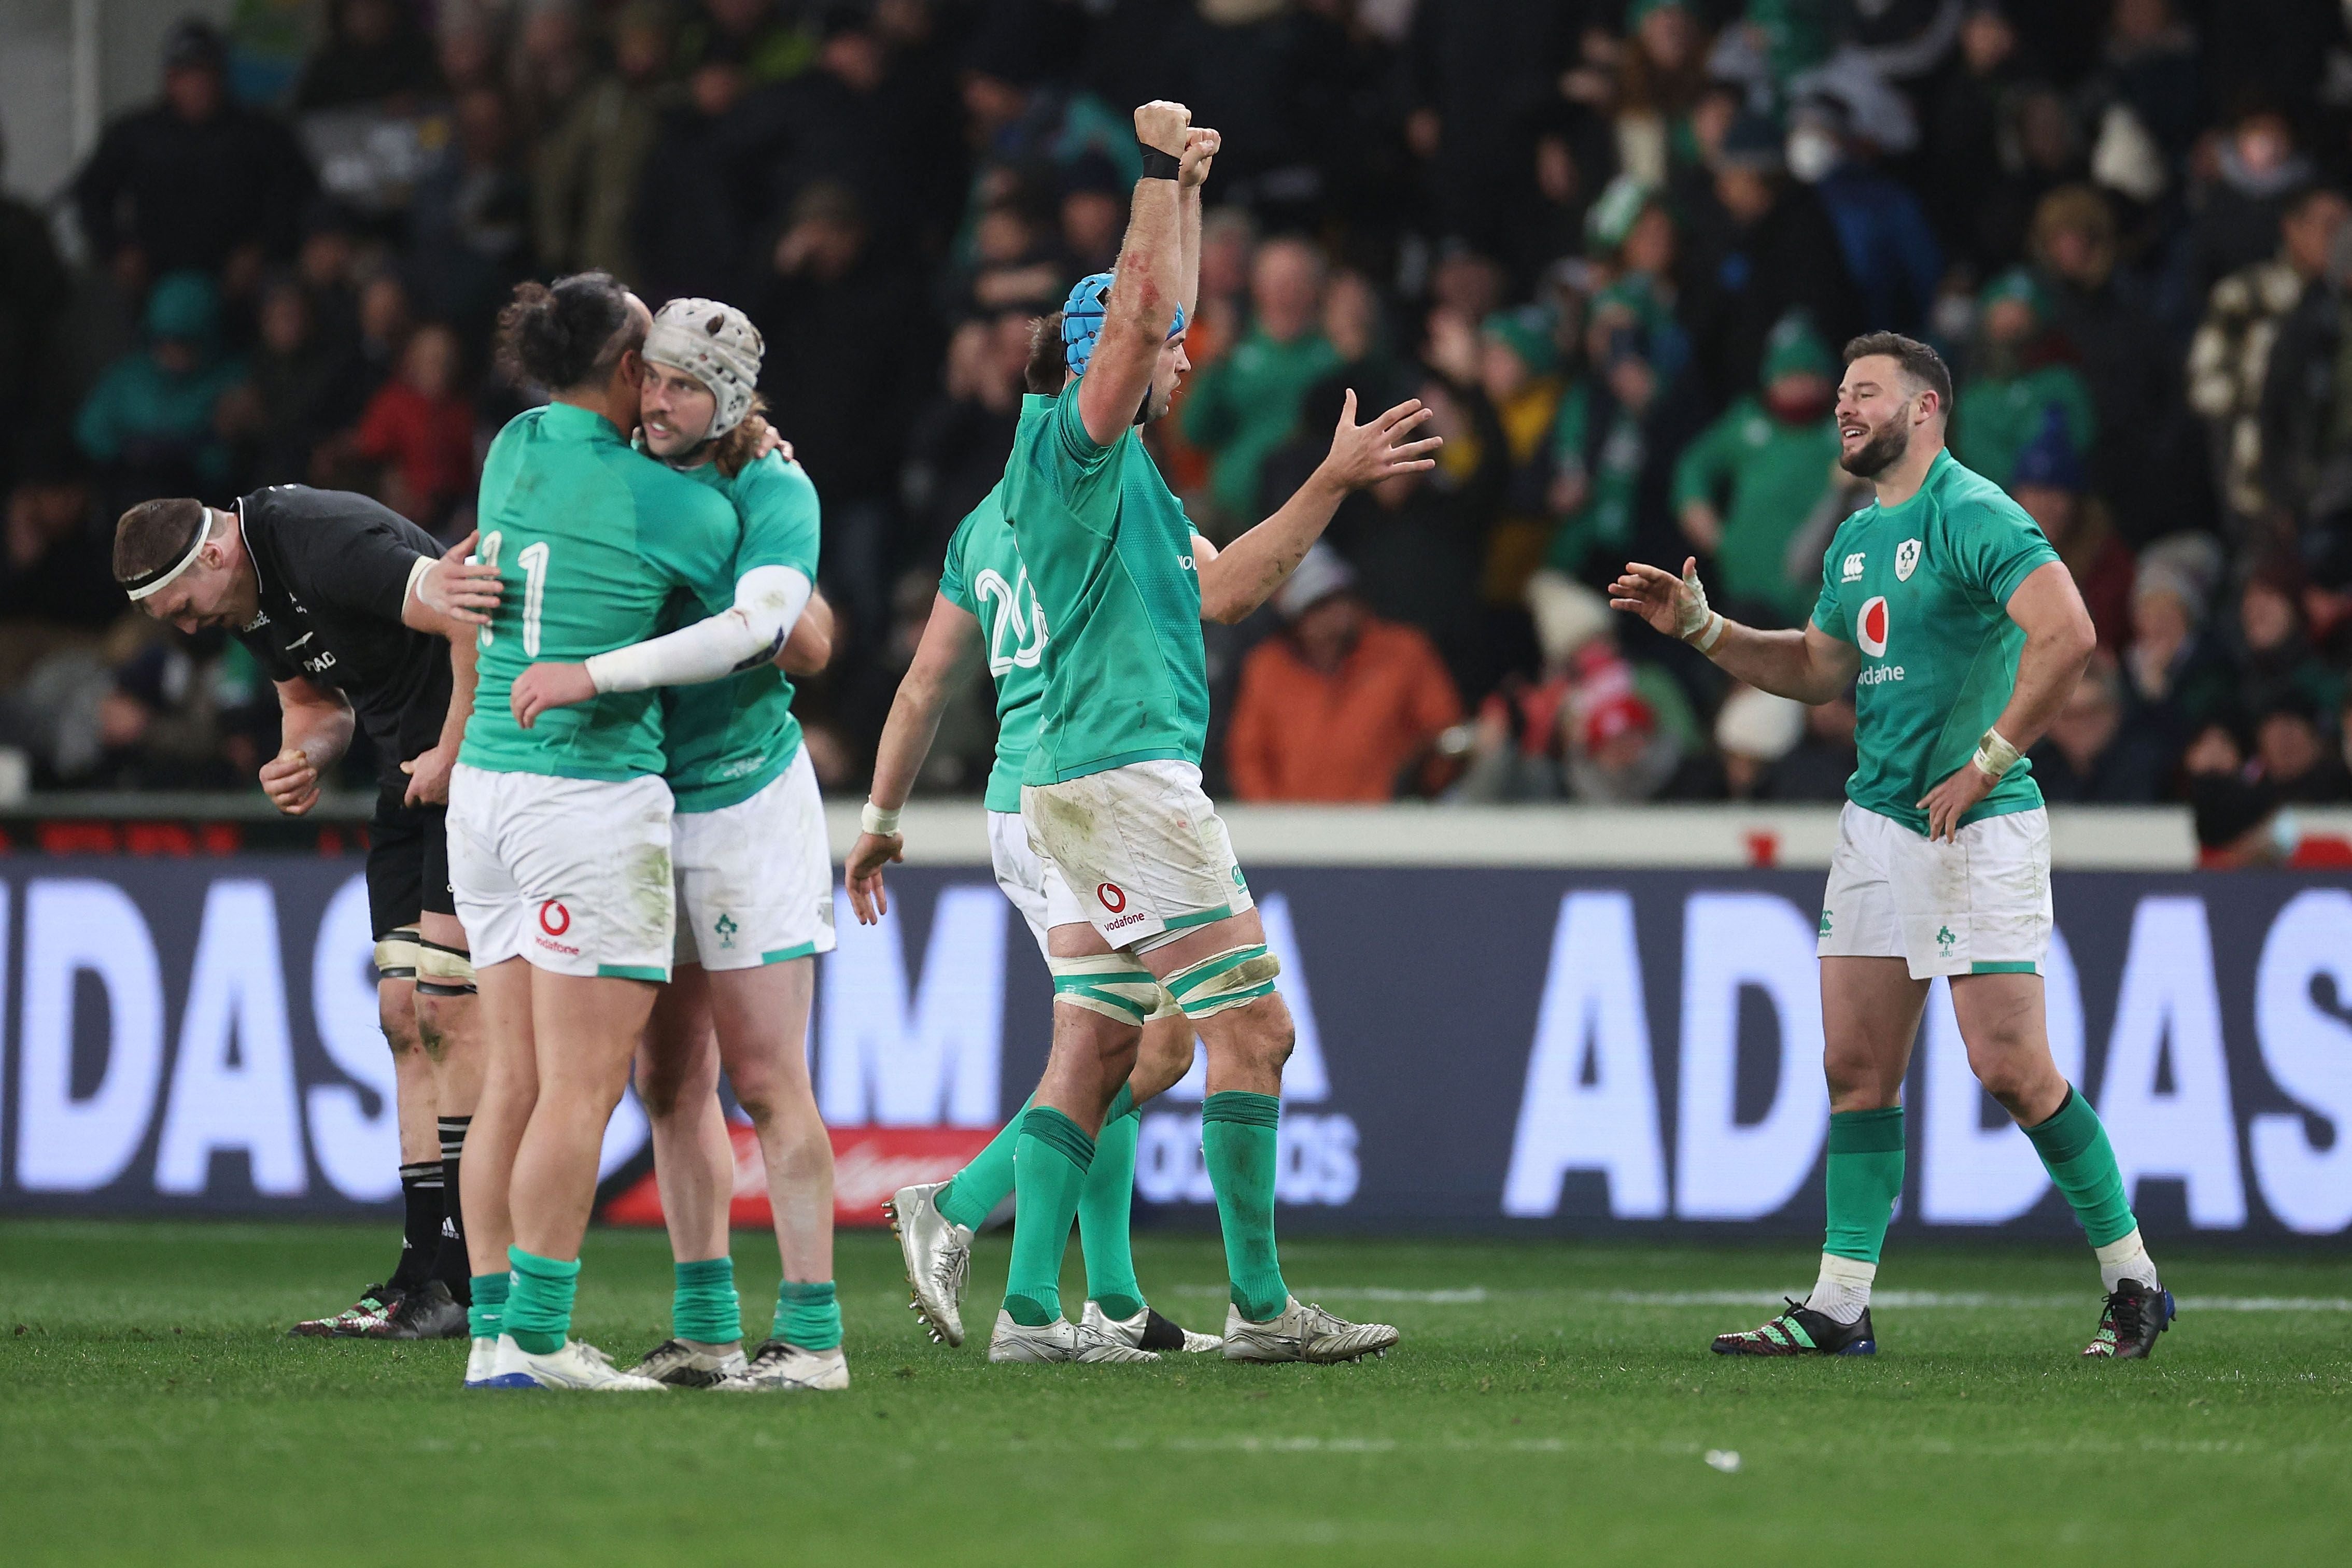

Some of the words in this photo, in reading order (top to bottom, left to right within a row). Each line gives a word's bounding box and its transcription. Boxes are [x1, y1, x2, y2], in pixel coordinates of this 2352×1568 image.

[481, 530, 550, 658] 11
[975, 563, 1050, 678] 20
[1104, 912, 1145, 932] vodafone
[0, 875, 405, 1203] DAS
[1502, 887, 2352, 1234] ADDAS
